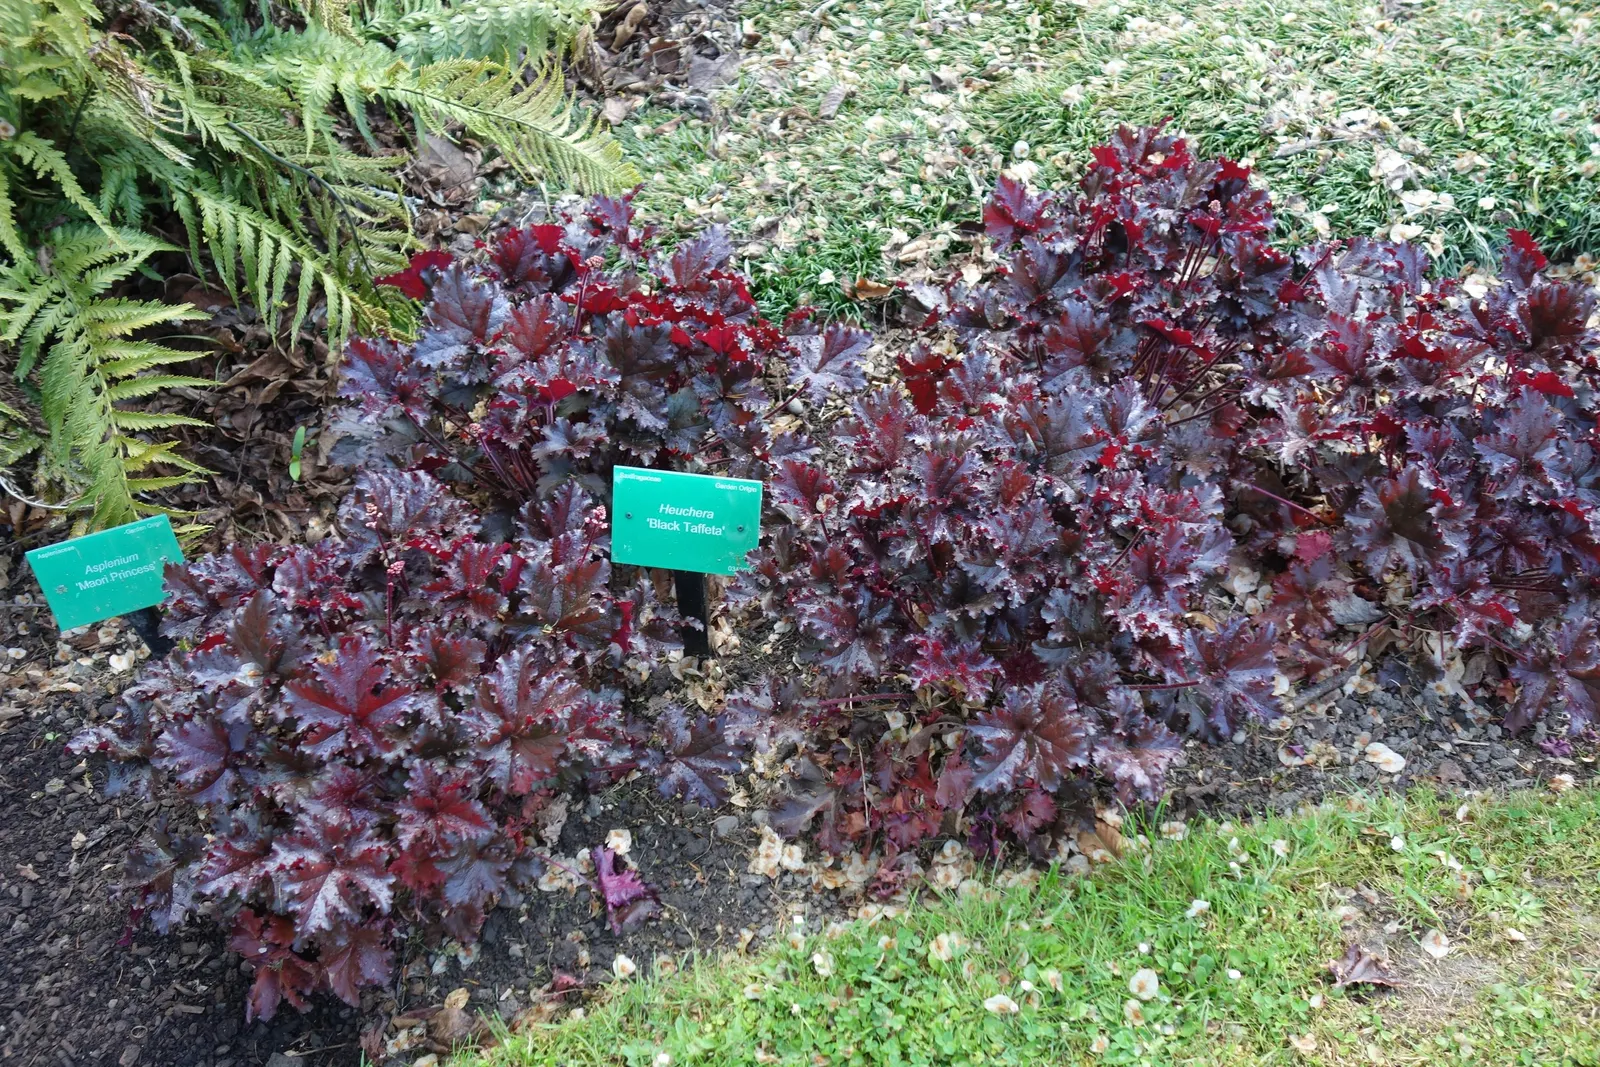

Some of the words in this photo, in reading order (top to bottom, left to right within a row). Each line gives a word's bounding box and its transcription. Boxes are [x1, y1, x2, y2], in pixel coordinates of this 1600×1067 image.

[715, 482, 738, 491] Garden
[739, 485, 757, 493] Origin
[659, 504, 715, 520] Heuchera
[646, 518, 680, 532] 'Black
[684, 522, 726, 536] Taffeta'
[85, 553, 139, 574] Asplenium
[76, 575, 109, 592] 'Maori
[110, 561, 156, 583] Princess'
